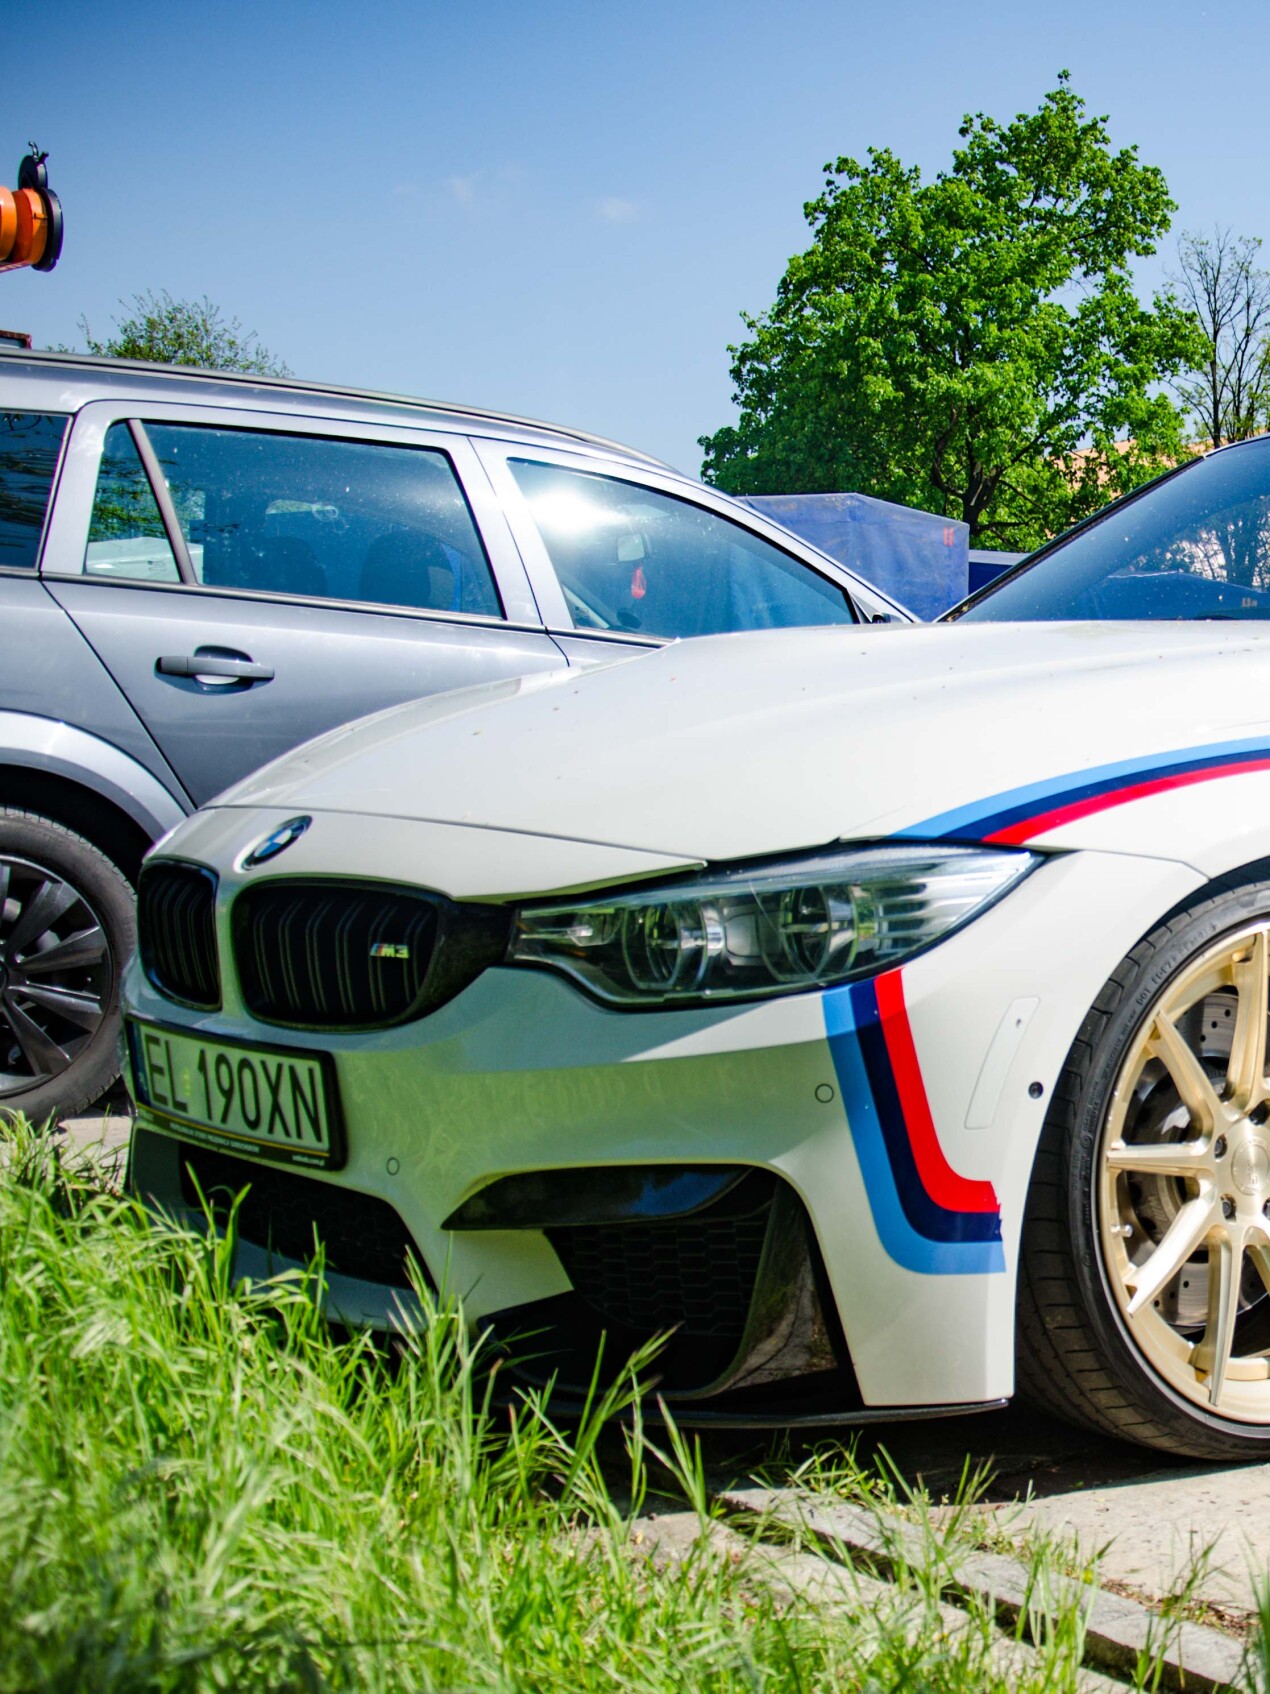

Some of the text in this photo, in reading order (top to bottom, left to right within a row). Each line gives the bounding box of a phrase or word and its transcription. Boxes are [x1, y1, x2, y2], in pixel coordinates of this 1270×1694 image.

[372, 944, 409, 958] M3
[144, 1033, 322, 1143] EL 190XN
